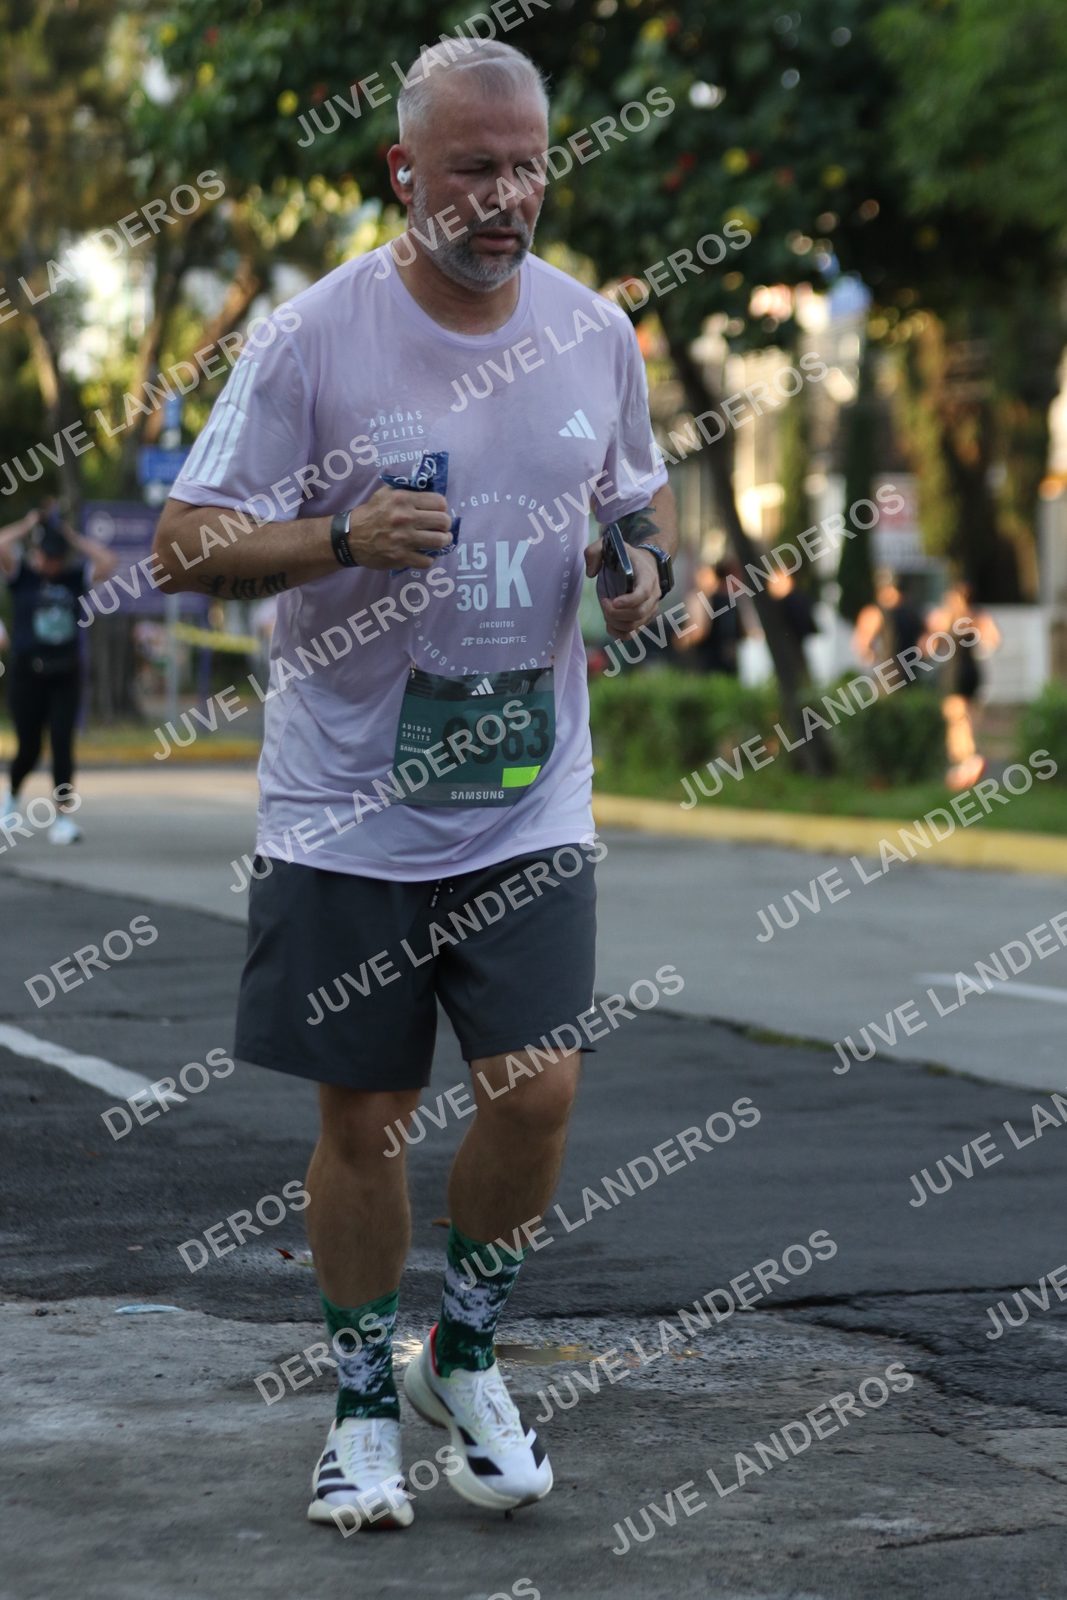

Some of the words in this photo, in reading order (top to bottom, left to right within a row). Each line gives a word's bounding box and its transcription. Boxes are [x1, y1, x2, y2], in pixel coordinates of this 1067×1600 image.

[369, 410, 423, 428] ADIDAS
[372, 425, 425, 442] SPLITS
[470, 491, 500, 506] GDL
[457, 543, 488, 571] 15
[496, 540, 533, 609] K
[456, 584, 488, 611] 30
[479, 620, 515, 629] CIRCUITOS
[476, 635, 528, 645] BANORTE
[402, 723, 432, 733] ADIDAS
[402, 732, 431, 742] SPLITS
[450, 790, 505, 800] SAMSUNG
